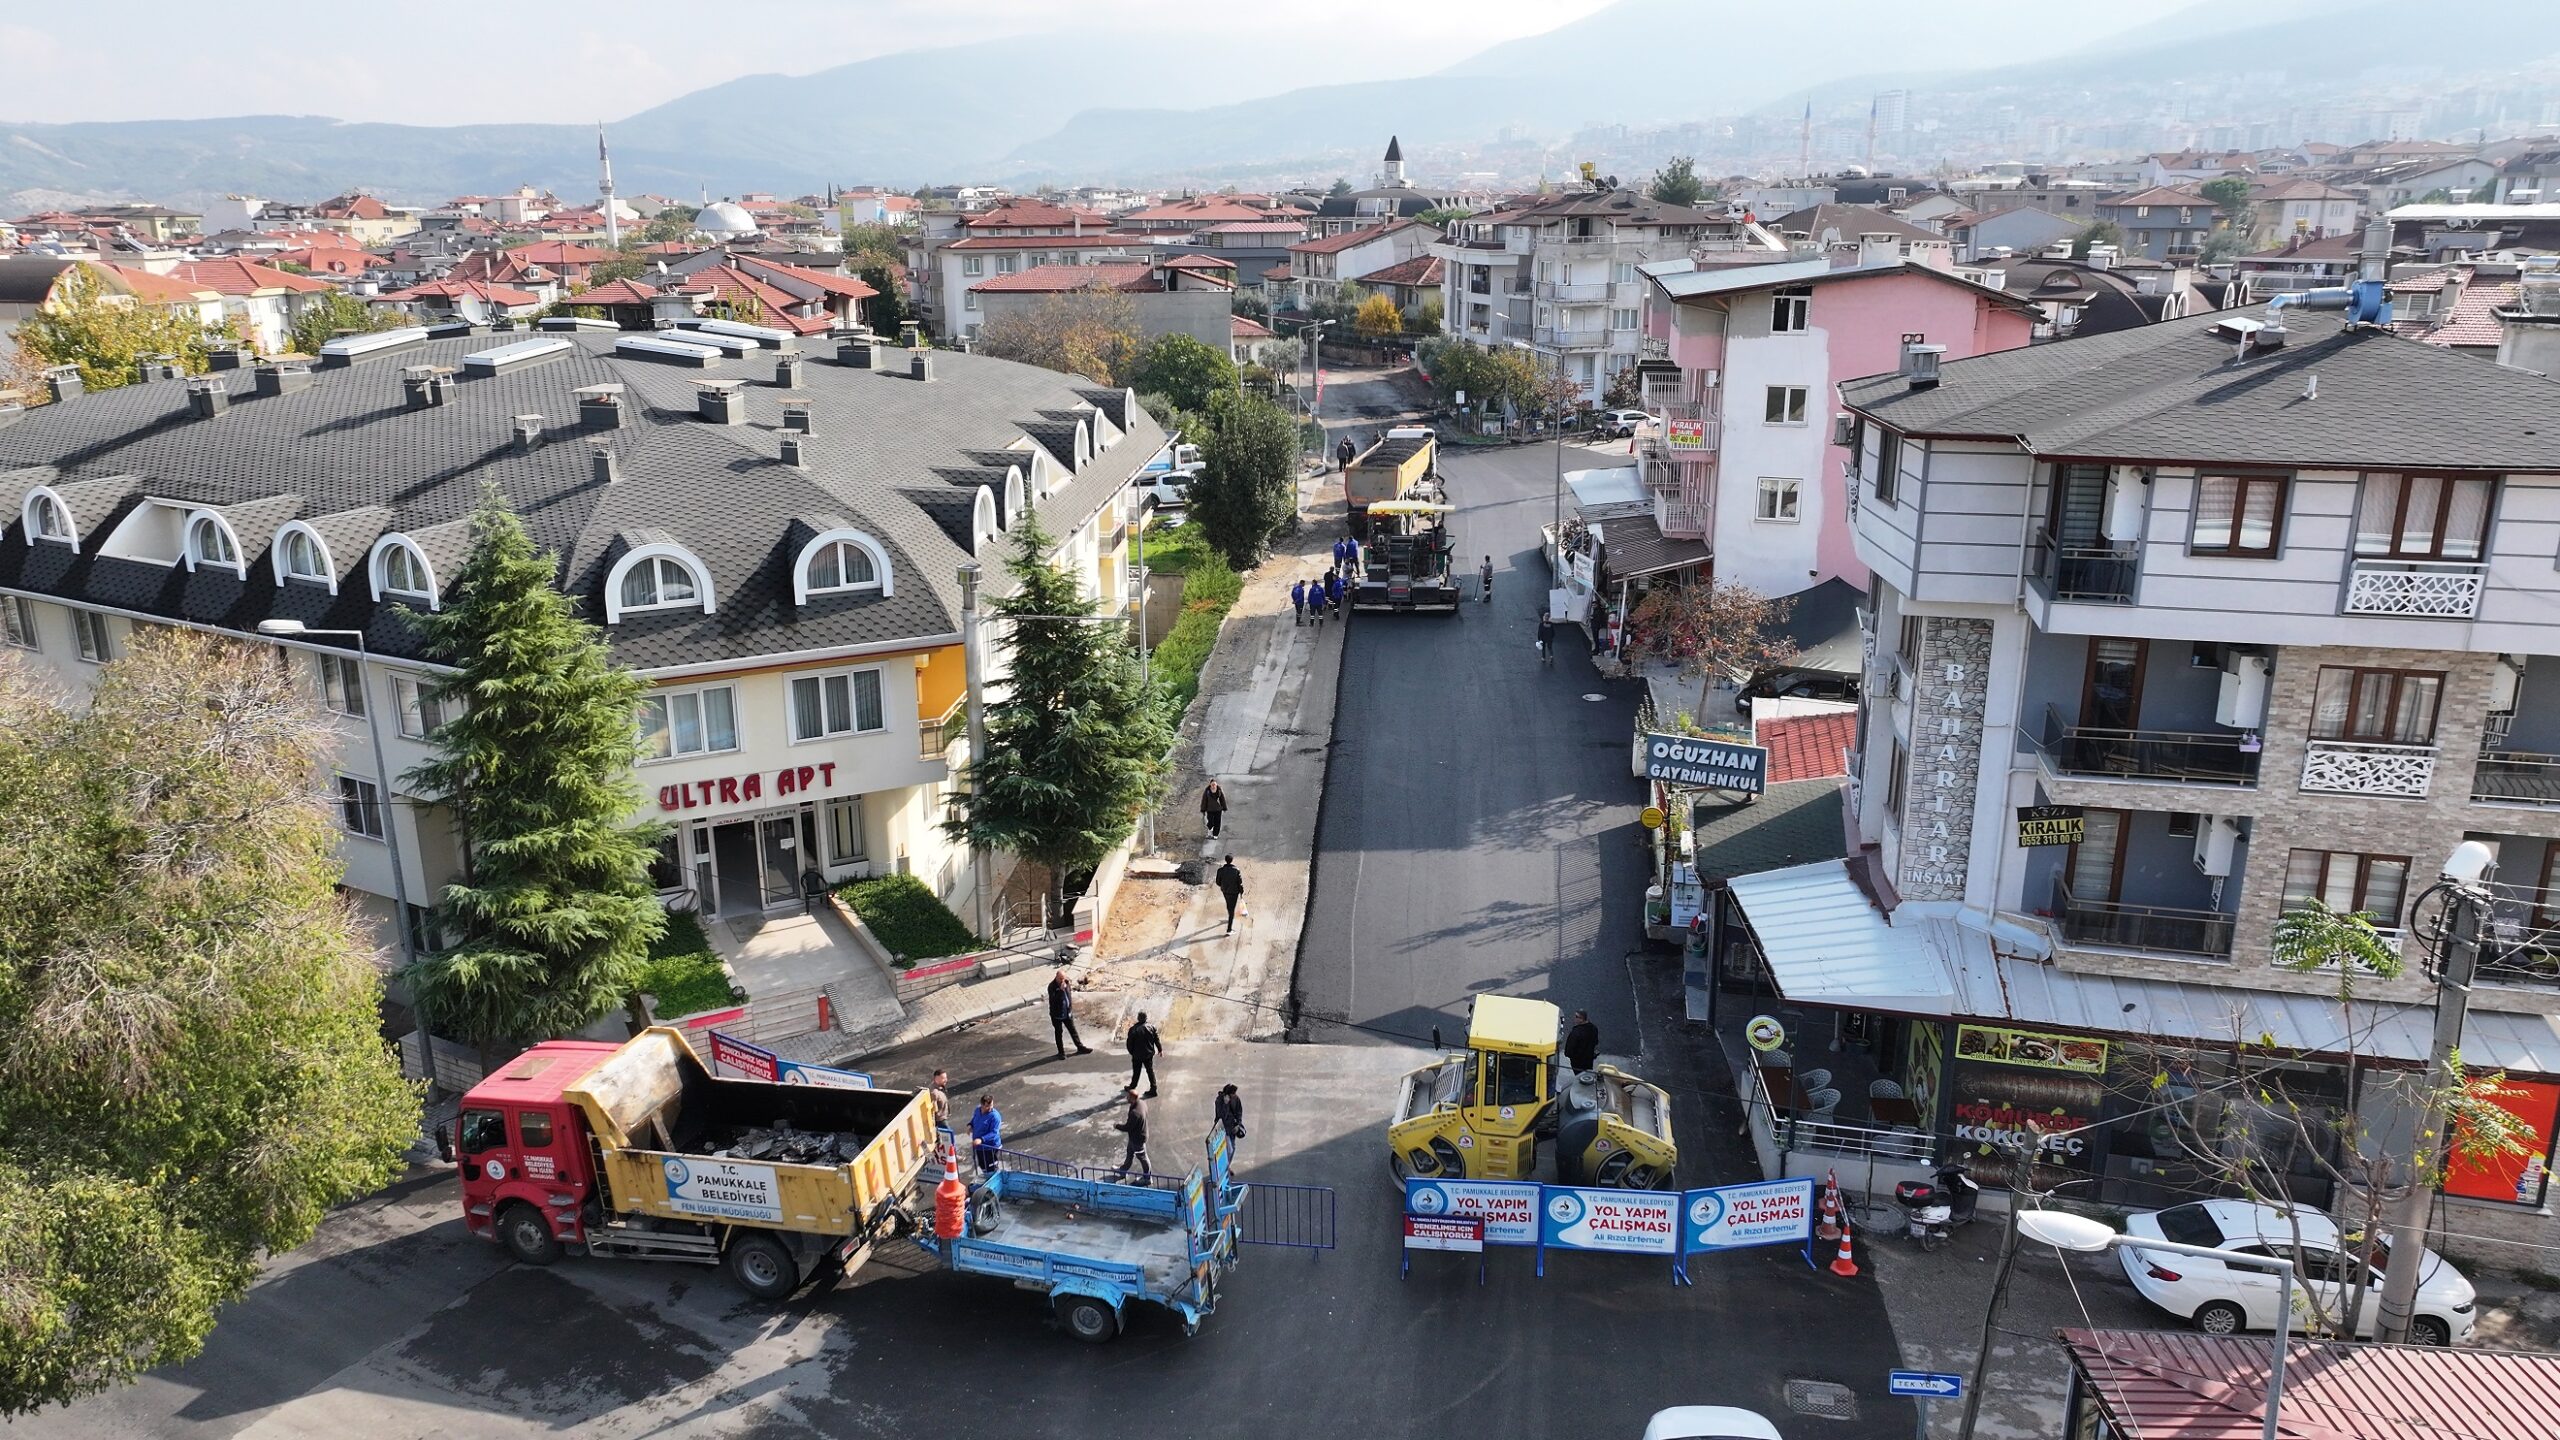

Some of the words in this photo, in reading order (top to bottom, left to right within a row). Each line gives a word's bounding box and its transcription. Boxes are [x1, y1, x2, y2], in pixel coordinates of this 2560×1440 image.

[1653, 739, 1758, 771] OĞUZHAN
[1928, 663, 1965, 863] BAHARLAR
[1650, 763, 1758, 791] GAYRİMENKUL
[658, 772, 762, 812] ULTRA
[777, 761, 836, 797] APT
[2021, 836, 2041, 846] 0552
[2043, 835, 2058, 845] 318
[2060, 834, 2070, 843] 00
[2072, 833, 2082, 842] 49
[720, 1165, 739, 1175] T.C.
[697, 1175, 767, 1191] PAMUKKALE
[702, 1189, 767, 1204] BELEDİYESİ
[1462, 1188, 1498, 1196] PAMUKKALE
[1739, 1188, 1773, 1199] PAMUKKALE
[1774, 1185, 1807, 1195] BELEDİYESİ
[1456, 1198, 1483, 1209] YOL
[1487, 1198, 1527, 1210] YAPIM
[1600, 1197, 1638, 1205] PAMUKKALE
[1733, 1200, 1757, 1212] YOL
[1761, 1195, 1800, 1208] YAPIM
[681, 1203, 695, 1212] FEN
[697, 1202, 719, 1214] İŞLERİ
[721, 1206, 771, 1219] MÜDÜRLÜĞÜ
[1594, 1205, 1621, 1217] YOL
[1625, 1207, 1667, 1220] YAPIM
[1727, 1207, 1804, 1227] ÇALIŞMASI
[1489, 1226, 1526, 1235] Ertemur
[1589, 1218, 1671, 1233] ÇALIŞMASI
[1763, 1224, 1799, 1234] Ertemur
[1594, 1233, 1604, 1241] Ali
[1628, 1235, 1665, 1244] Ertemur
